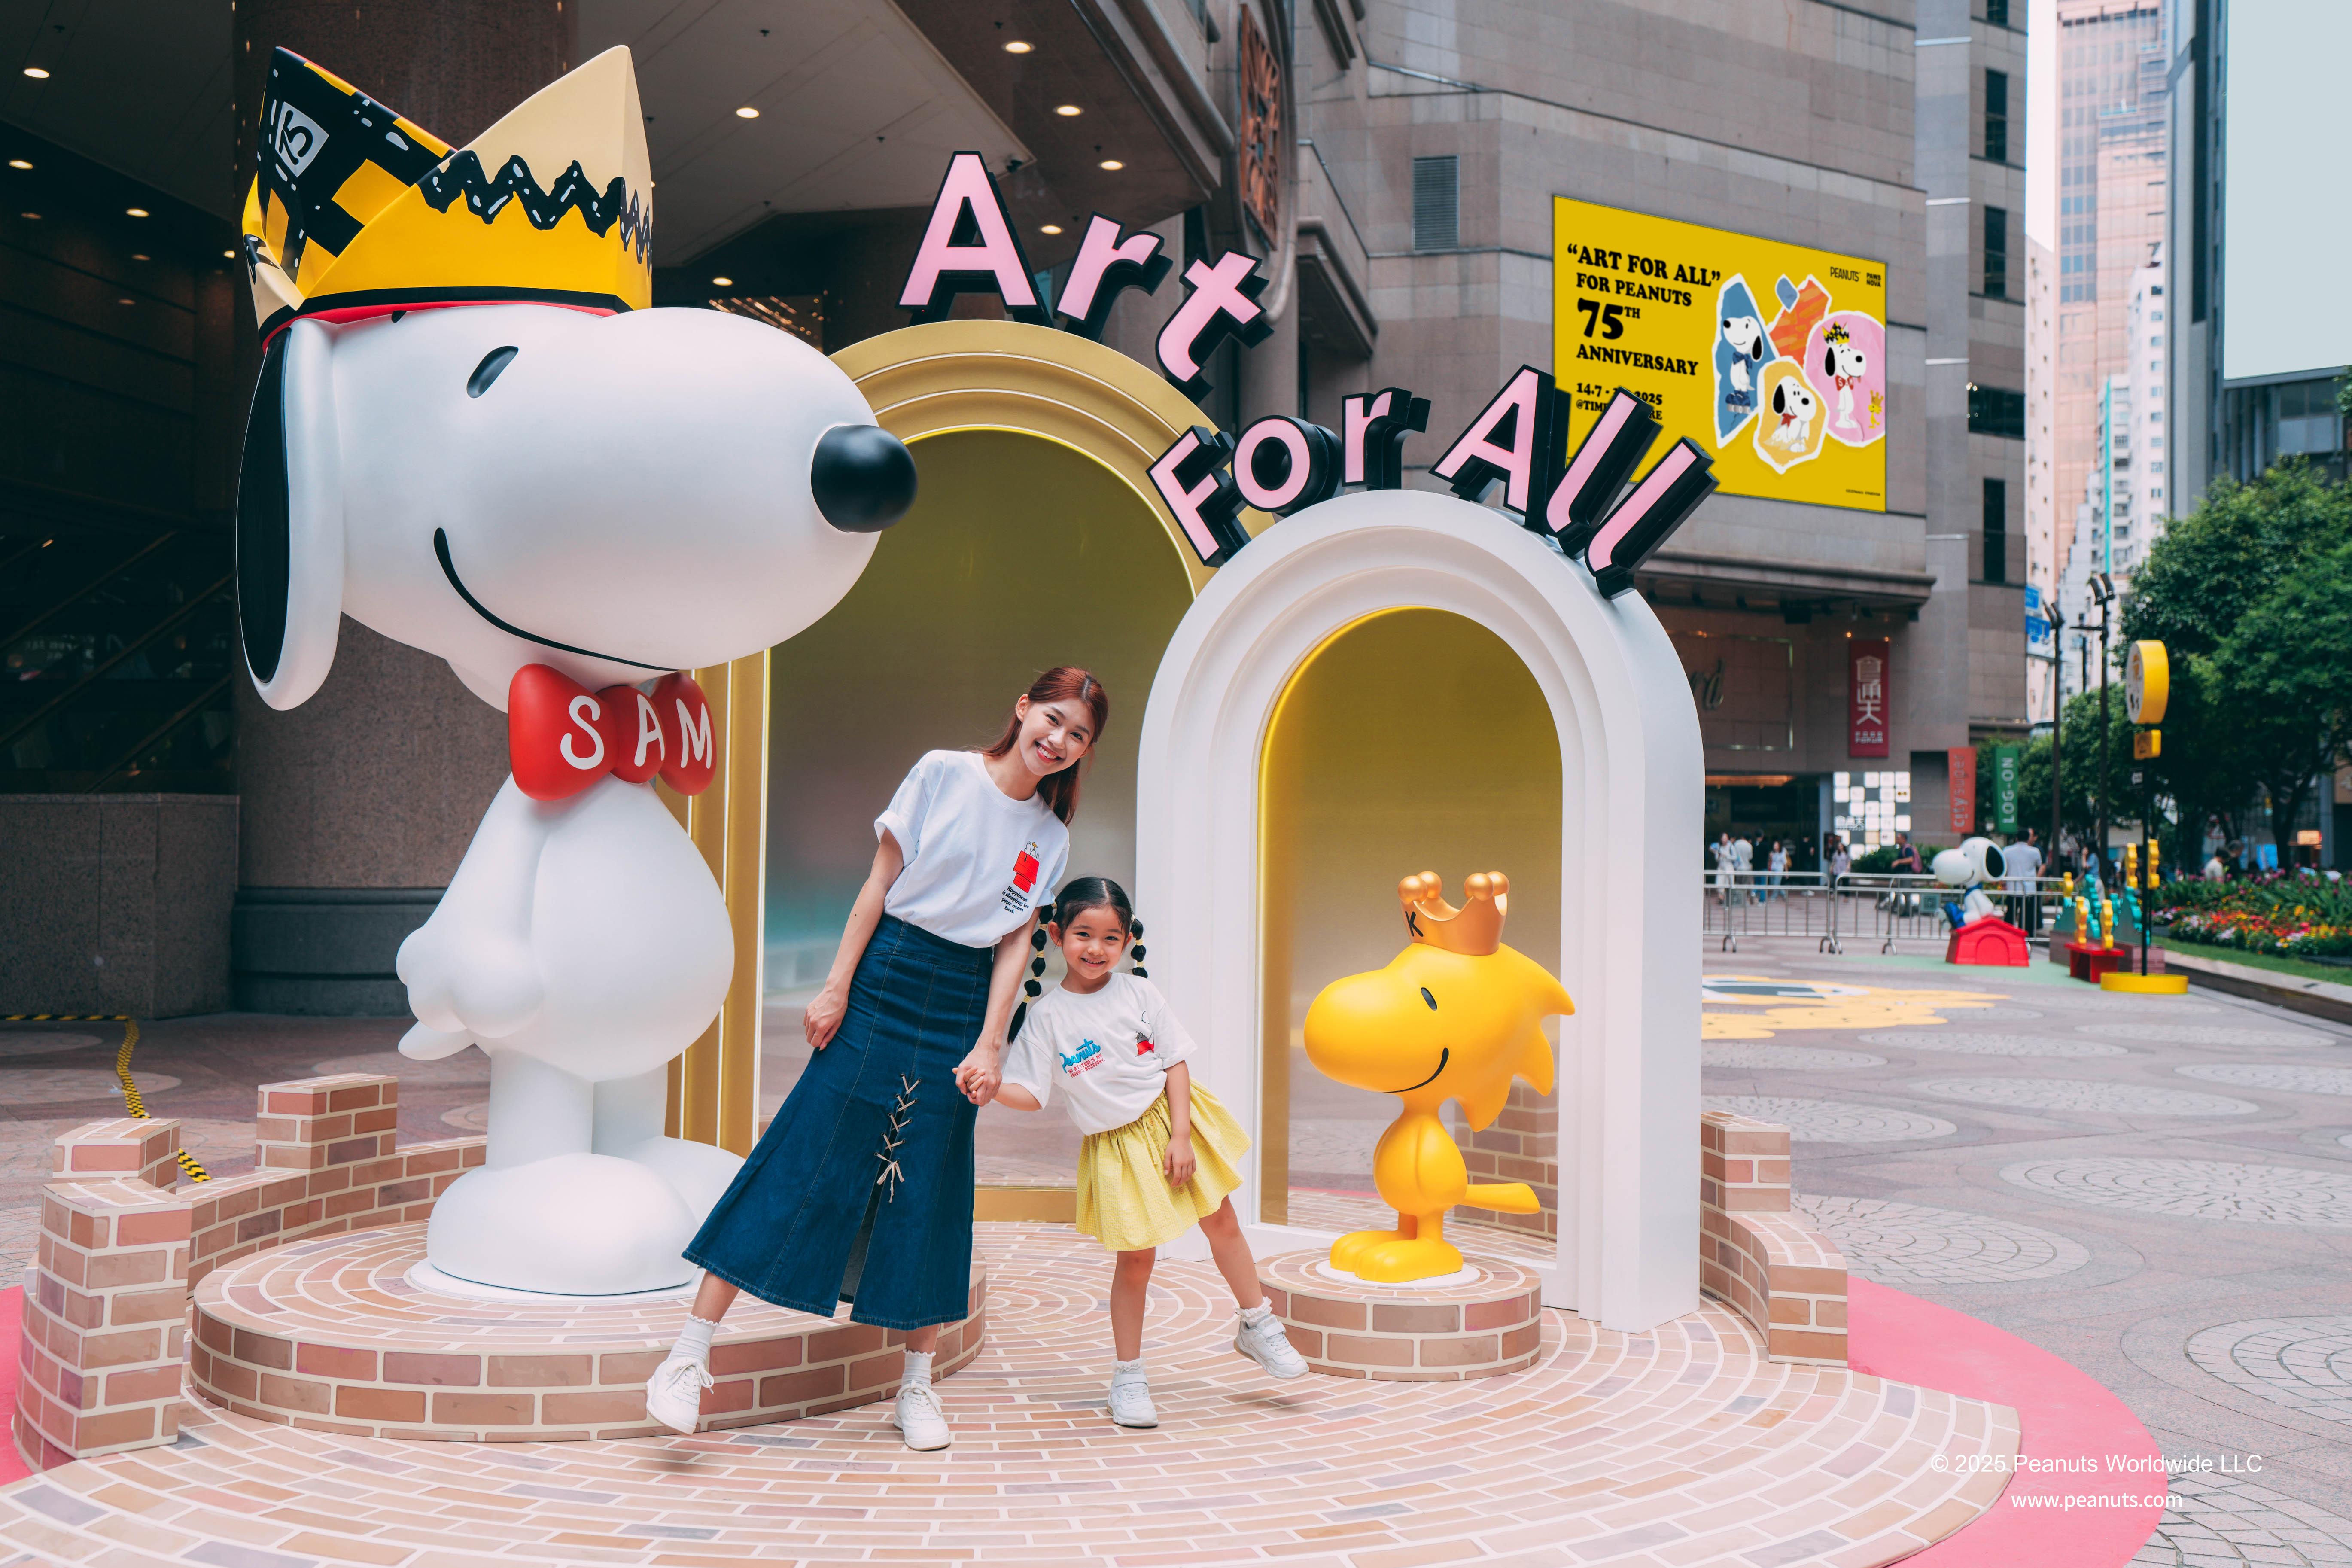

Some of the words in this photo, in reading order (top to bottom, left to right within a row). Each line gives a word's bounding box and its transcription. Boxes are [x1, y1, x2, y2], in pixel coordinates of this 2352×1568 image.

[895, 150, 1269, 384] Art
[1627, 254, 1668, 279] FOR
[1866, 272, 1881, 280] PAWS
[1576, 272, 1610, 293] FOR
[1615, 279, 1692, 306] PEANUTS
[1576, 344, 1699, 376] ANNIVERSARY
[1576, 383, 1602, 397] 14.7
[1146, 387, 1413, 568] For
[1428, 364, 1716, 584] All
[2002, 757, 2014, 824] LOG-ON
[1001, 898, 1012, 906] your
[1005, 893, 1023, 906] sleeping
[1007, 886, 1028, 902] Happiness
[1004, 905, 1015, 914] bed.
[1059, 1038, 1101, 1074] Peanuts
